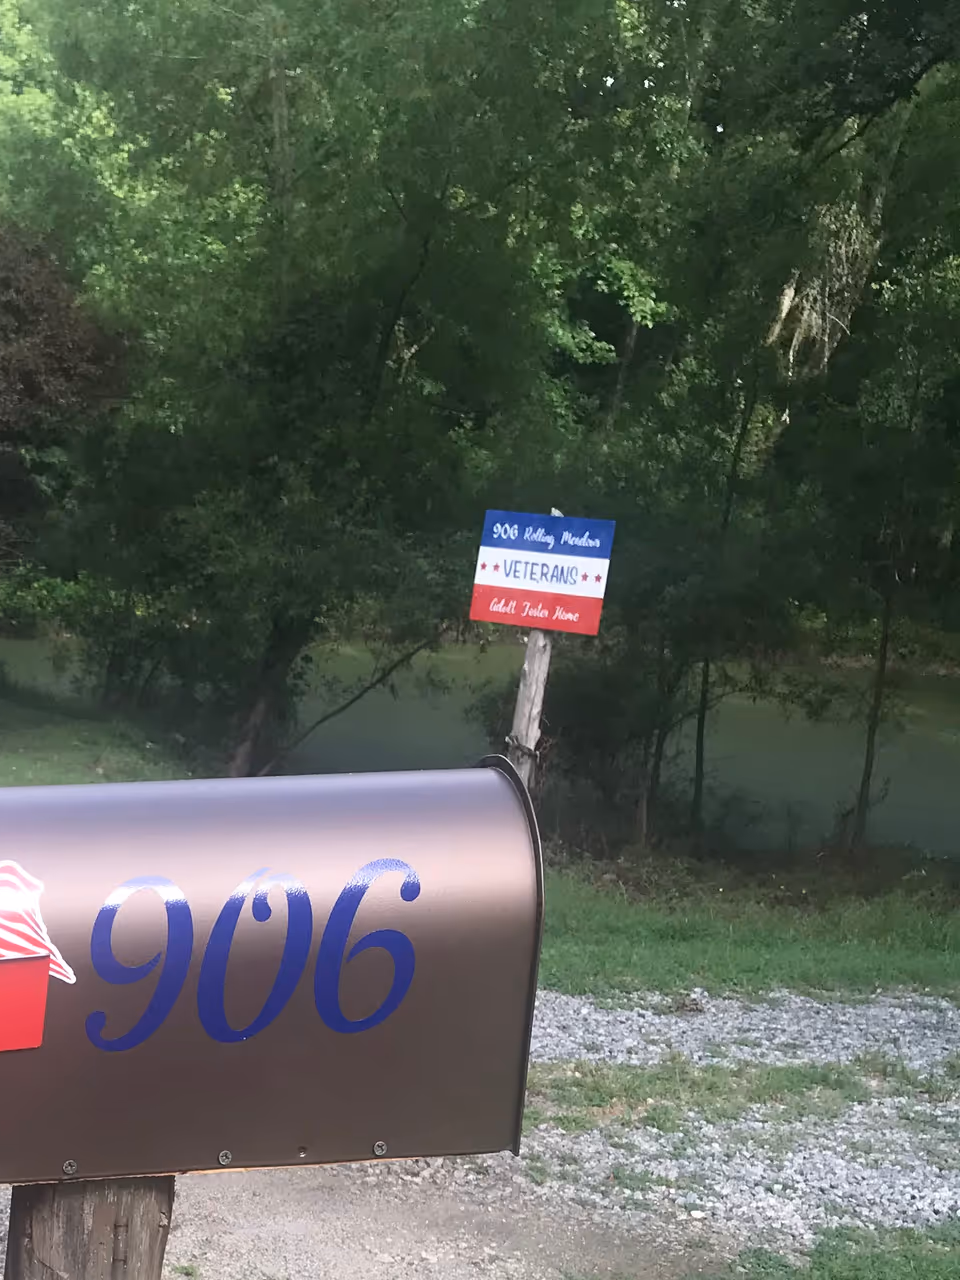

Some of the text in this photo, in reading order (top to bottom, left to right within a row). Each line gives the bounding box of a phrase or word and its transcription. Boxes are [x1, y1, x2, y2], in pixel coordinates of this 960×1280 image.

[493, 522, 518, 540] 906
[523, 526, 555, 550] Rolling
[503, 559, 579, 585] VETERANS
[521, 601, 549, 618] Foster
[552, 605, 580, 622] Home
[84, 857, 422, 1052] 906
